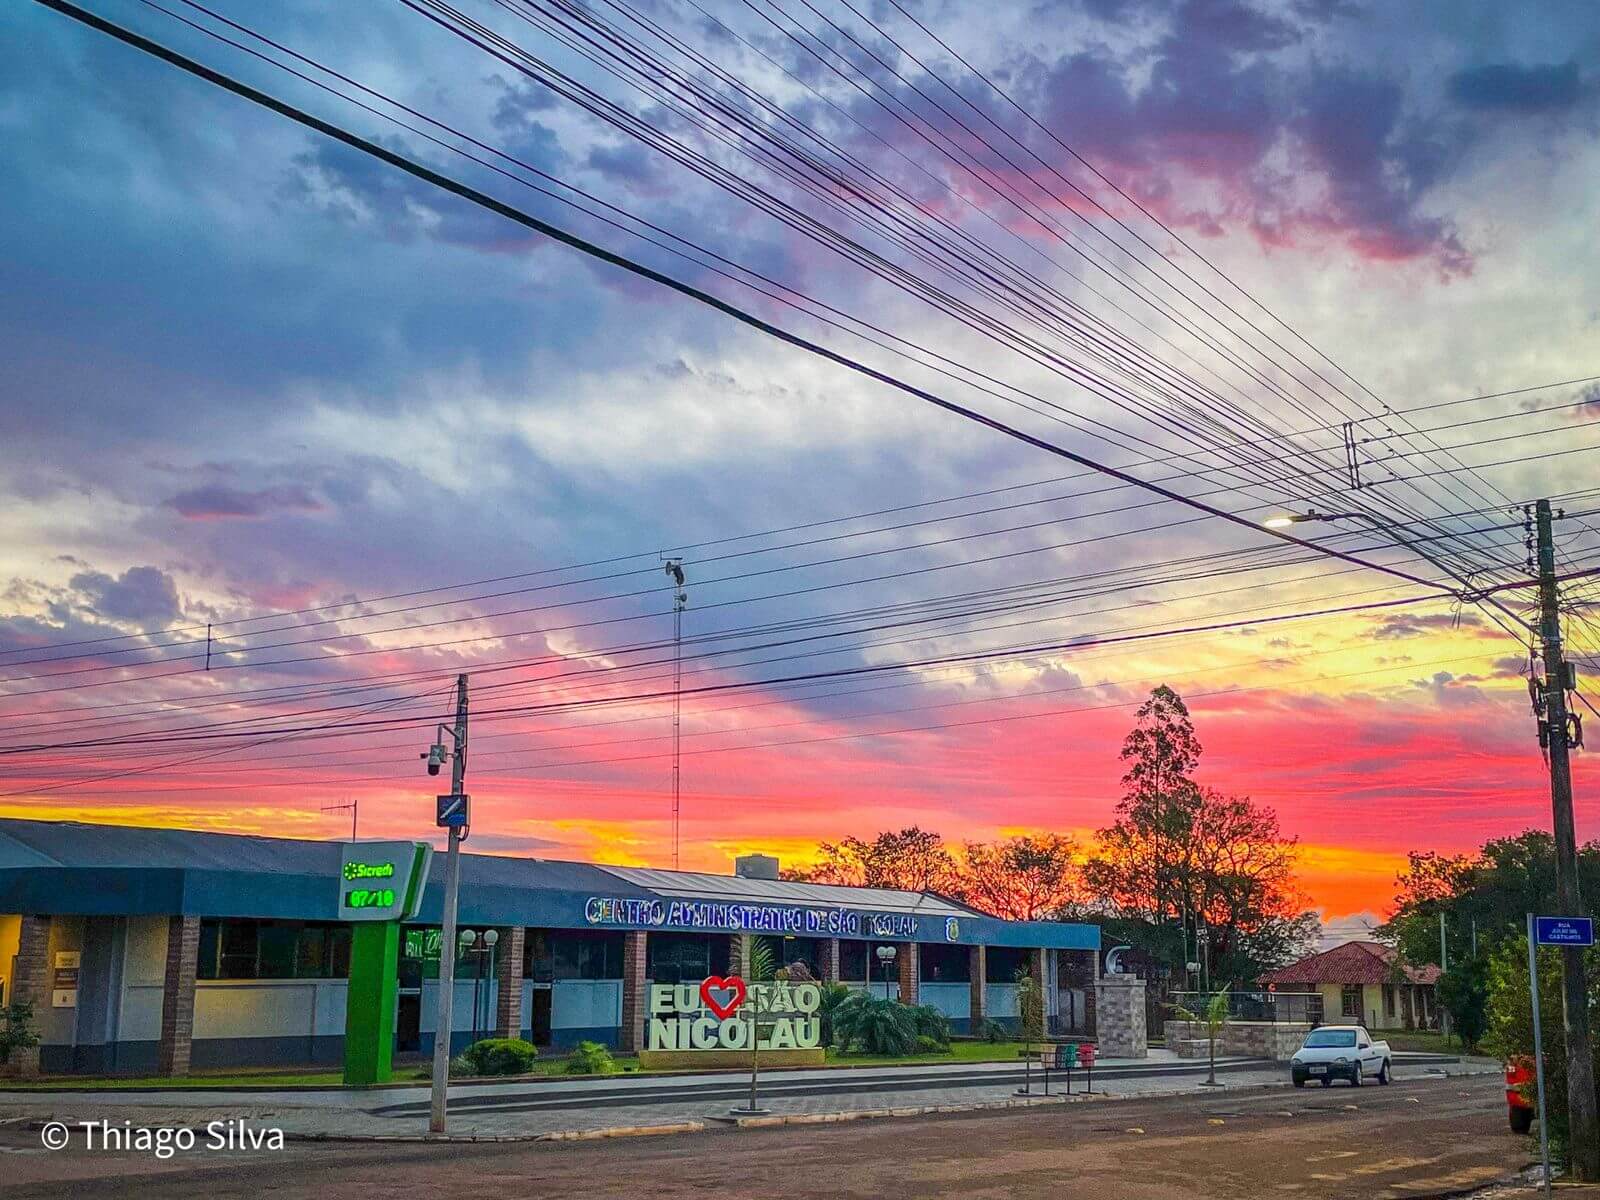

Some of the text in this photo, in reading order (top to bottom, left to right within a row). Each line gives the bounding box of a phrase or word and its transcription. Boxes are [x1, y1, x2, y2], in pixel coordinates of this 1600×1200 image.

[357, 864, 393, 877] Sicredi
[585, 896, 666, 926] CENTRO
[806, 910, 827, 933] DE
[650, 980, 821, 1014] EU SÃO
[649, 1017, 821, 1050] NICOLAU
